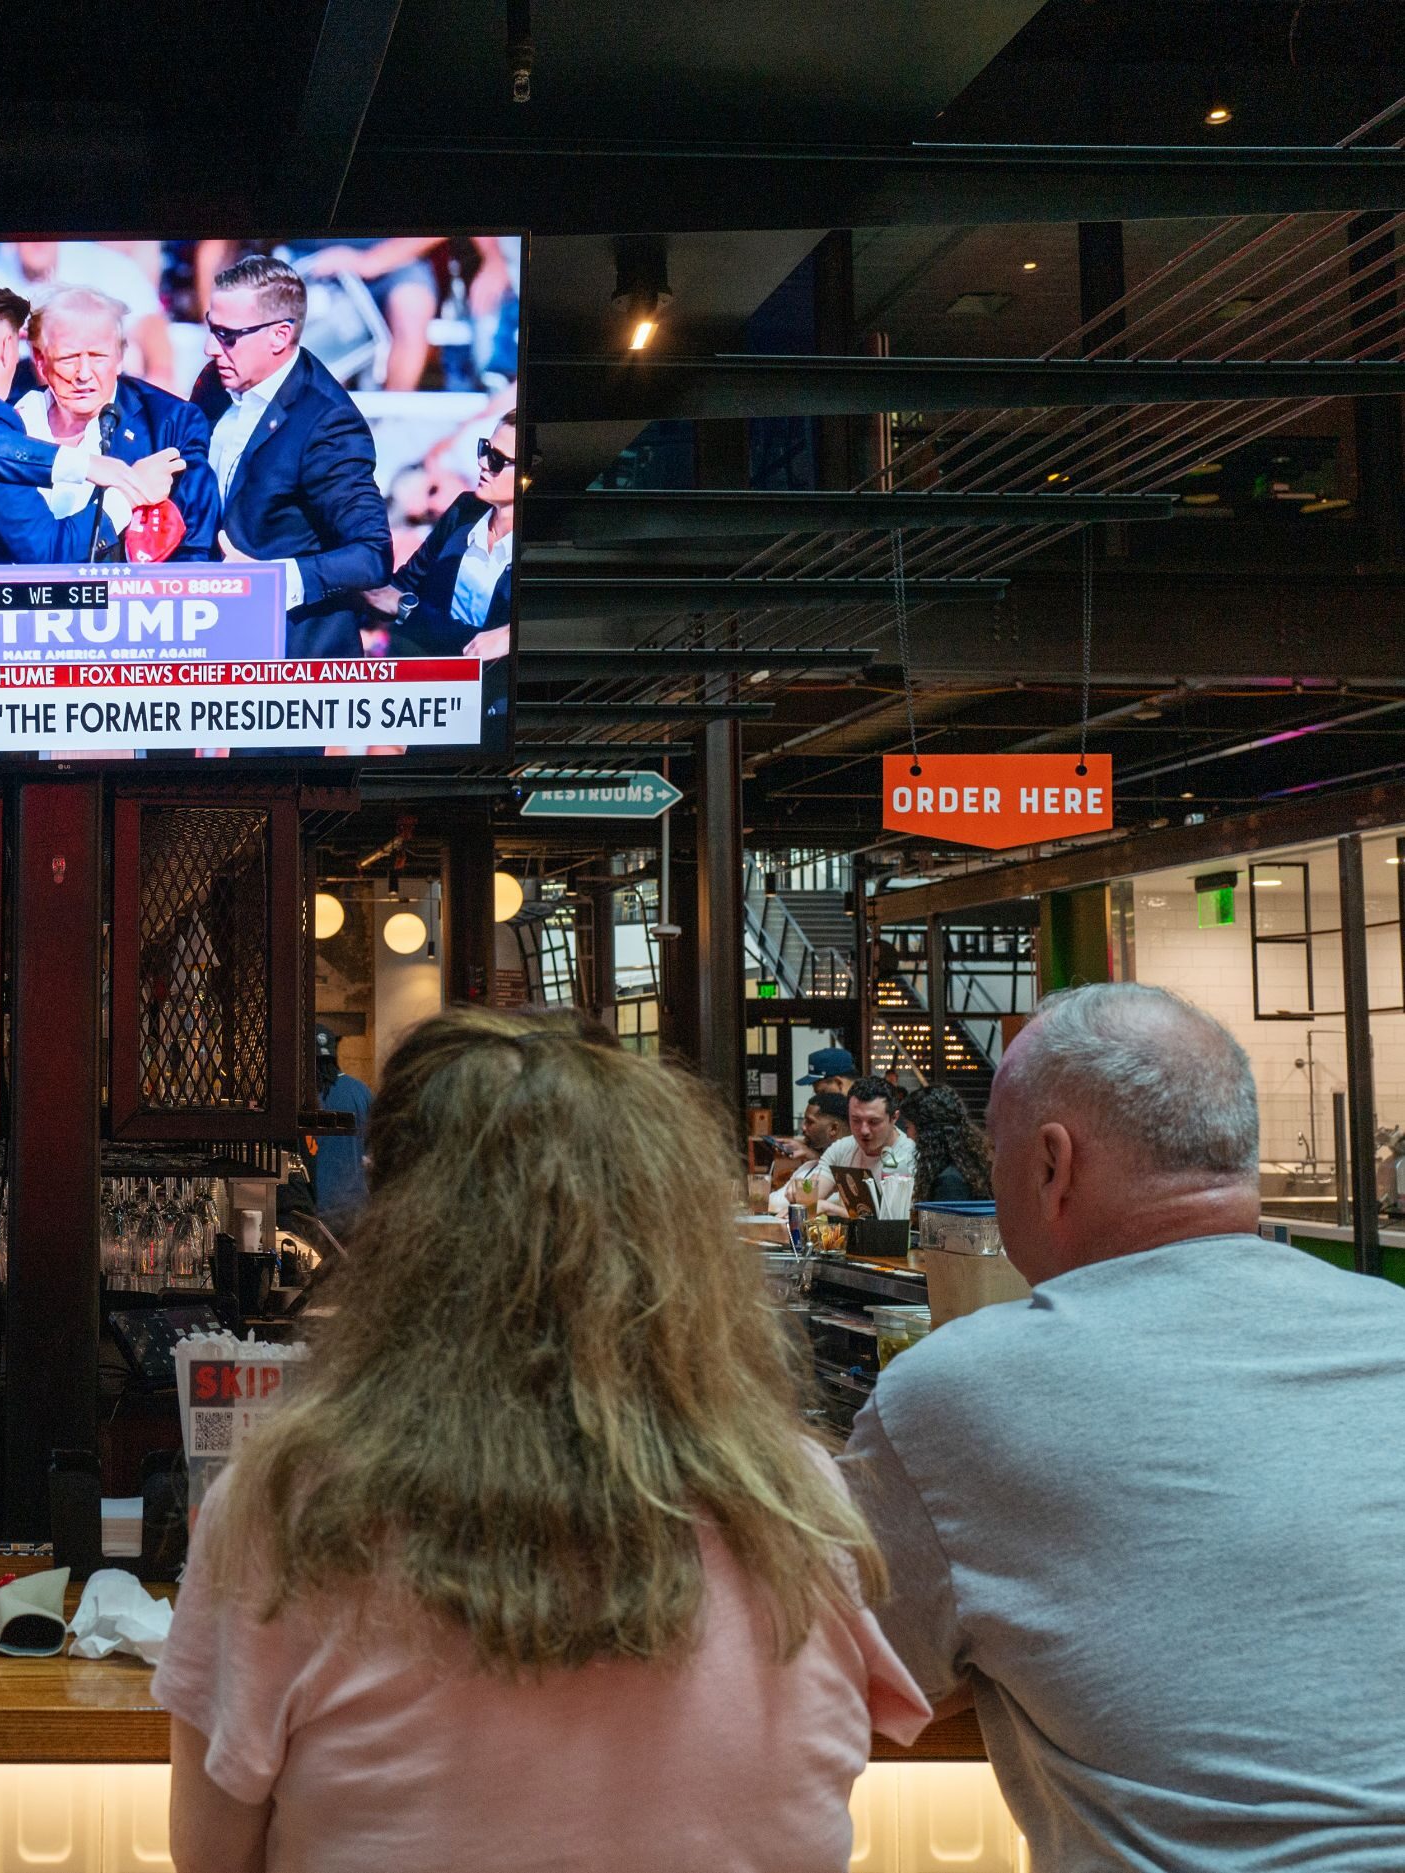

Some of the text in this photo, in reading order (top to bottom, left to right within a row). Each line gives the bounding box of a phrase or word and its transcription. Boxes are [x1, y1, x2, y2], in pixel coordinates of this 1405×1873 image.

[29, 587, 53, 604] WE
[68, 586, 106, 604] SEE
[159, 580, 183, 594] TO
[187, 579, 243, 594] 88022
[3, 649, 41, 660] MAKE
[45, 649, 107, 660] AMERICA
[111, 648, 155, 659] GREAT
[79, 666, 115, 684] FOX
[121, 665, 173, 683] NEWS
[178, 664, 226, 683] CHIEF
[231, 663, 314, 683] POLITICAL
[319, 662, 398, 681] ANALYST
[66, 701, 181, 733] FORMER
[191, 699, 340, 732] PRESIDENT
[348, 698, 371, 729] IS
[380, 697, 462, 729] SAFE"
[892, 786, 1104, 814] ORDER HERE
[196, 1365, 282, 1400] SKIP
